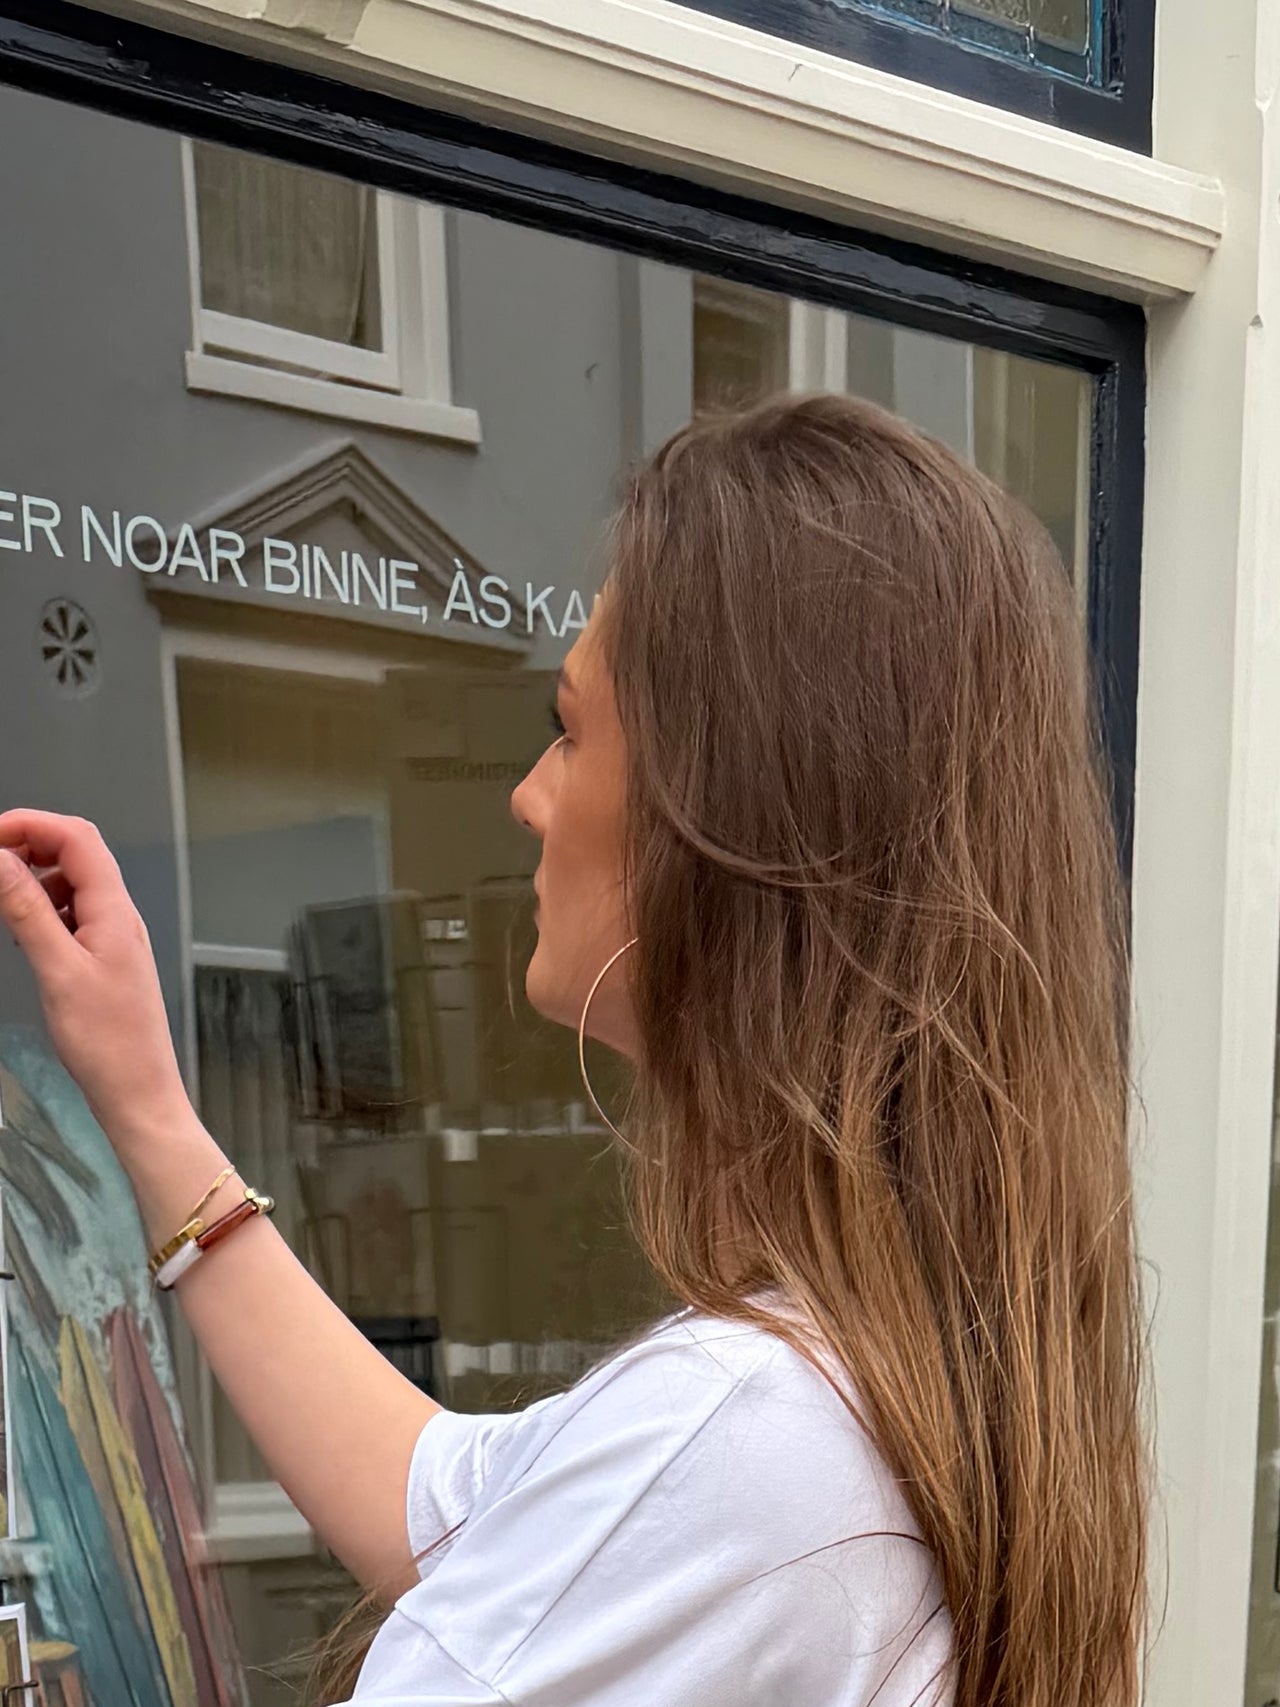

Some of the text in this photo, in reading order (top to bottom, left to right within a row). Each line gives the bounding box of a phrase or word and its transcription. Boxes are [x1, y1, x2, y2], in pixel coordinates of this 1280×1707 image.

[81, 504, 248, 588] NOAR
[264, 537, 428, 625] BINNE,
[444, 558, 512, 629] ÀS
[526, 581, 601, 638] KA
